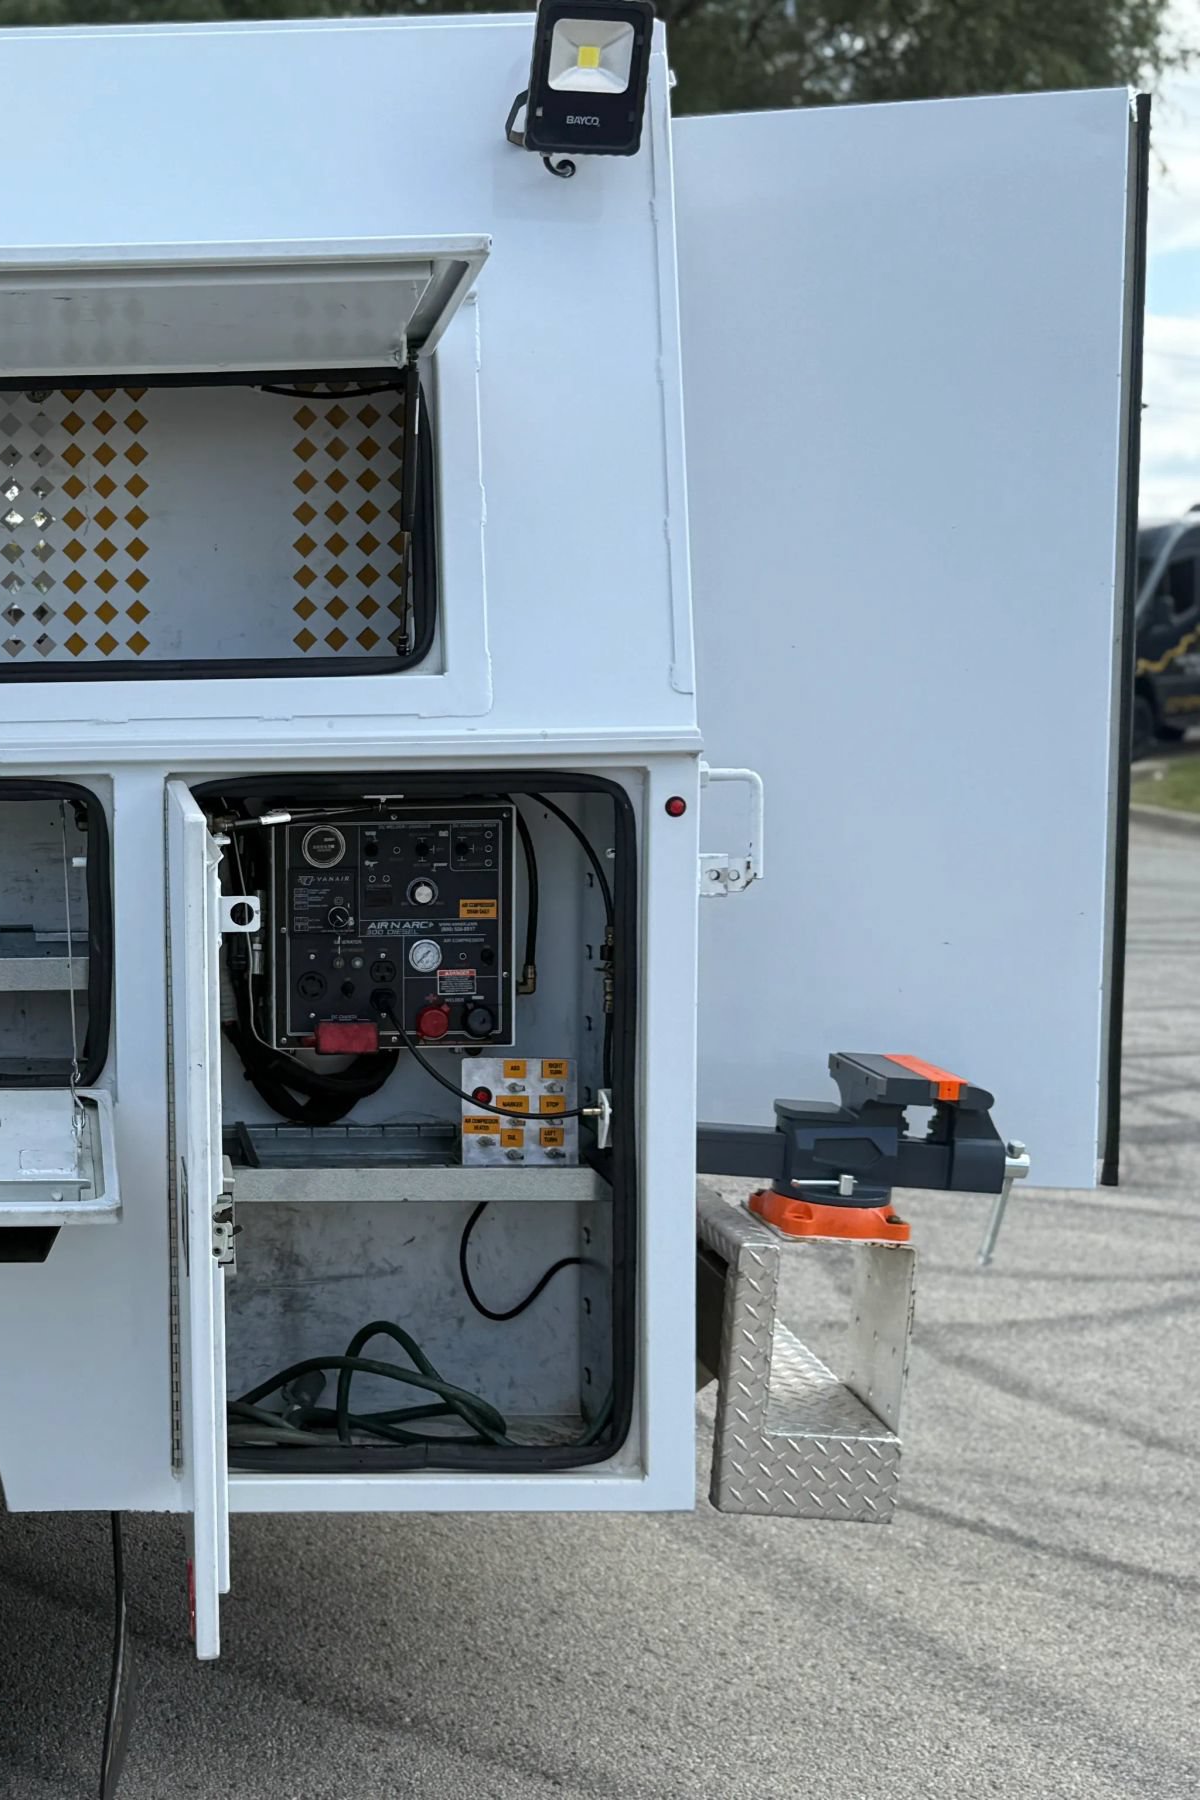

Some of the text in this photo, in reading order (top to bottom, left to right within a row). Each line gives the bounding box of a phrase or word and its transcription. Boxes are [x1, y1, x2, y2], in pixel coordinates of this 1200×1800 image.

[566, 115, 600, 126] BAYCO
[368, 921, 429, 930] AIR N ARC
